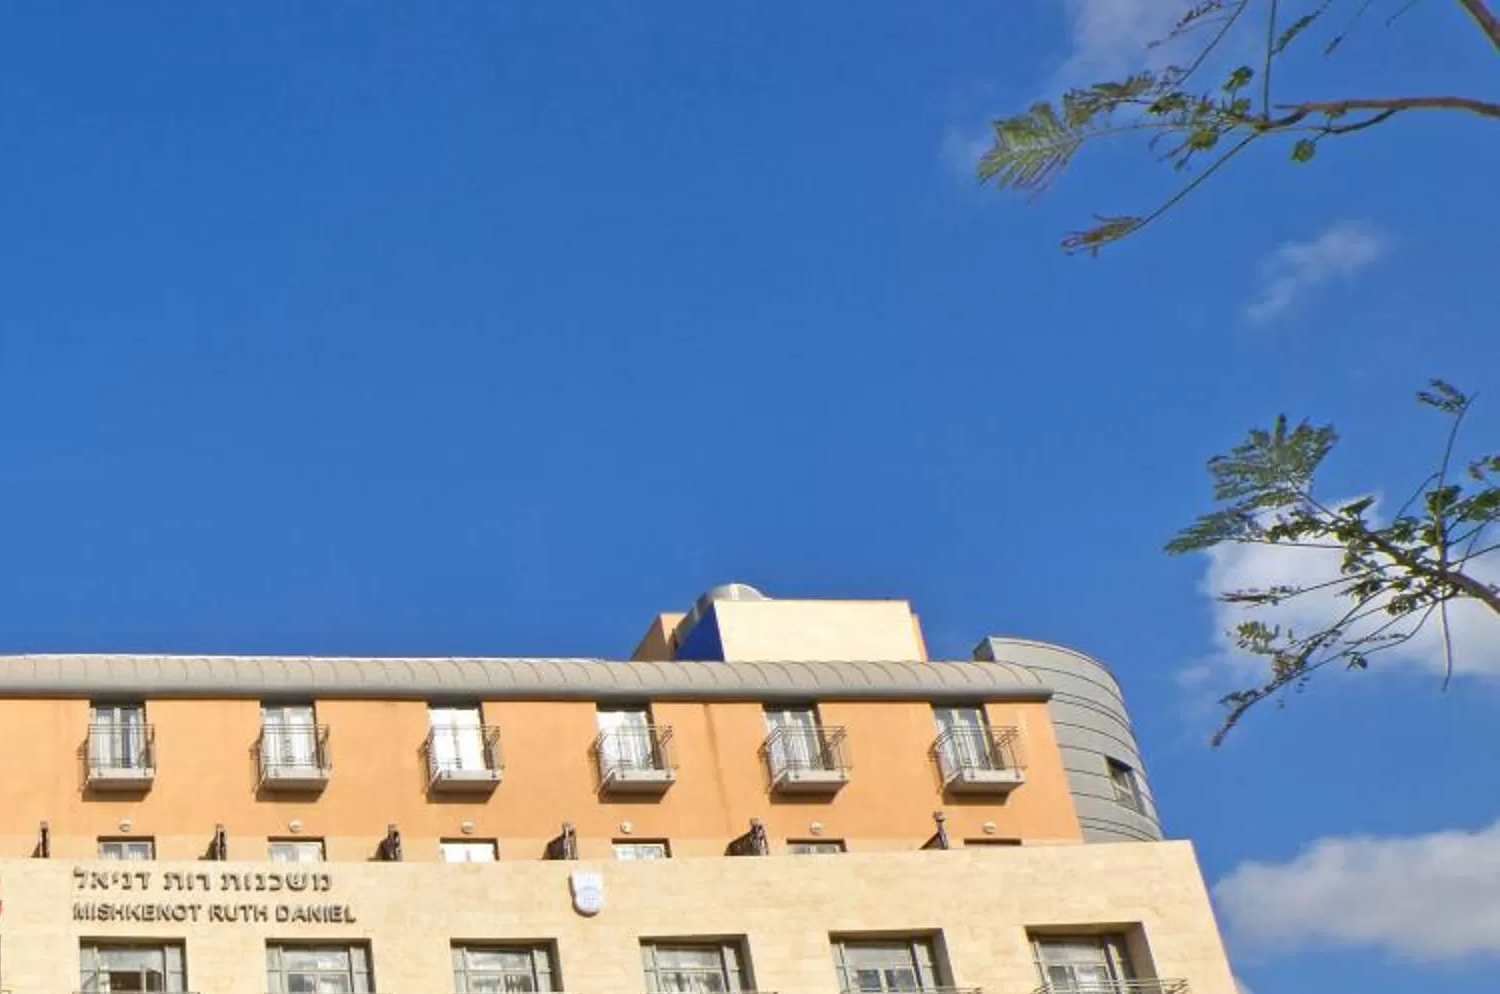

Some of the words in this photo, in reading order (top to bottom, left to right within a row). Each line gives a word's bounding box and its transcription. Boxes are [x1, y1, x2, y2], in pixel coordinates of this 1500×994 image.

[73, 865, 152, 892] דניאל
[163, 870, 212, 892] רות
[220, 870, 333, 893] משכנות
[72, 902, 202, 923] MISHKENOT
[208, 903, 269, 924] RUTH
[275, 903, 357, 925] DANIEL
